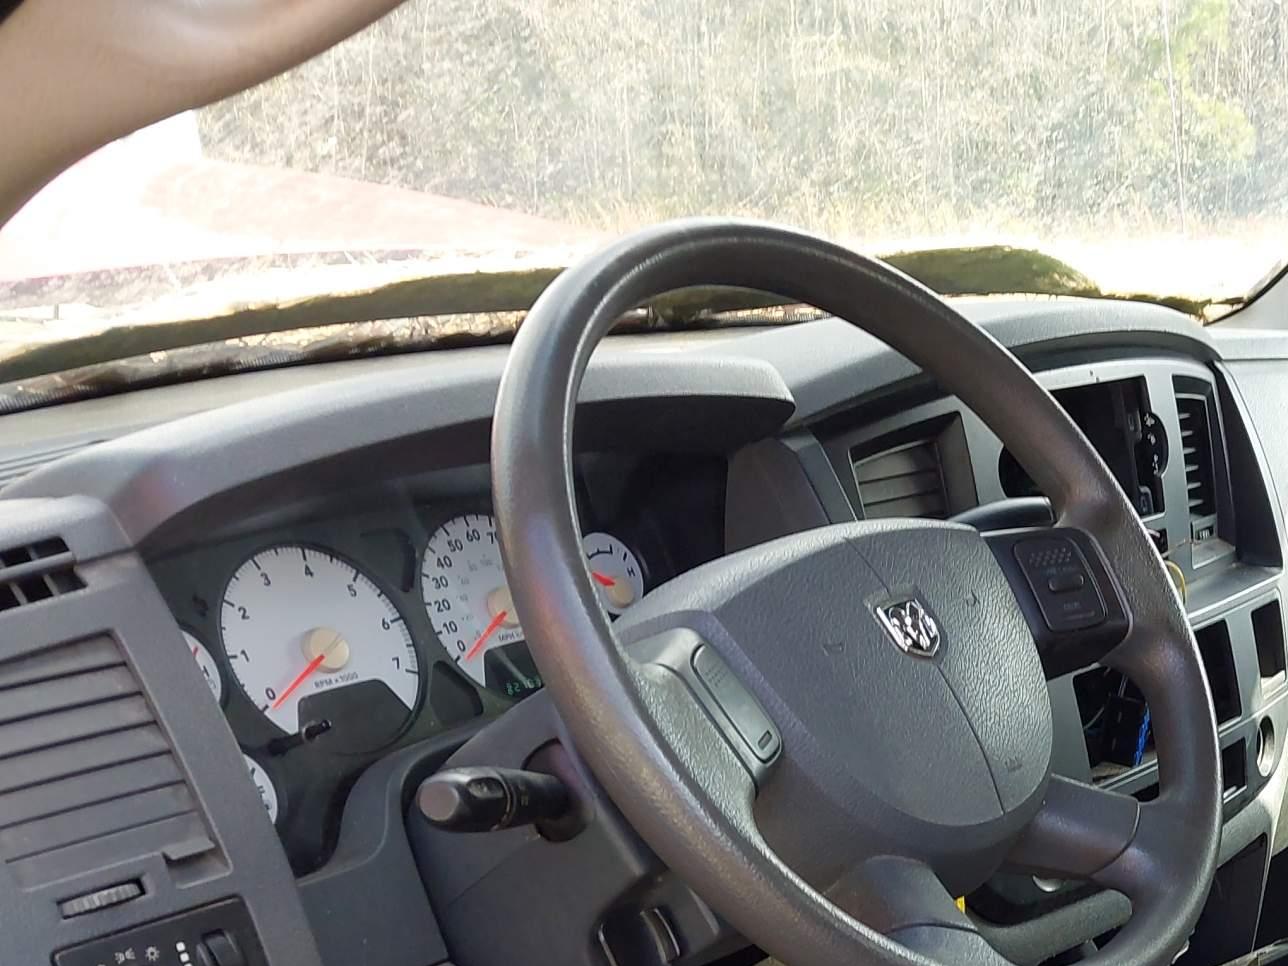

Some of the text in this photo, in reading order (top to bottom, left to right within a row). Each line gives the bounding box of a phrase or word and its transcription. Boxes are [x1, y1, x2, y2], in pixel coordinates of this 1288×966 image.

[465, 528, 481, 542] 60
[447, 538, 464, 552] 50
[436, 555, 453, 569] 40
[304, 563, 314, 578] 4
[260, 572, 271, 587] 3
[432, 575, 448, 589] 30
[347, 583, 357, 598] 5
[434, 598, 451, 613] 20
[238, 606, 250, 620] 2
[381, 617, 390, 630] 6
[442, 620, 458, 635] 10
[457, 640, 466, 652] 0
[240, 650, 250, 663] 1
[391, 657, 401, 670] 7
[265, 687, 276, 700] 0
